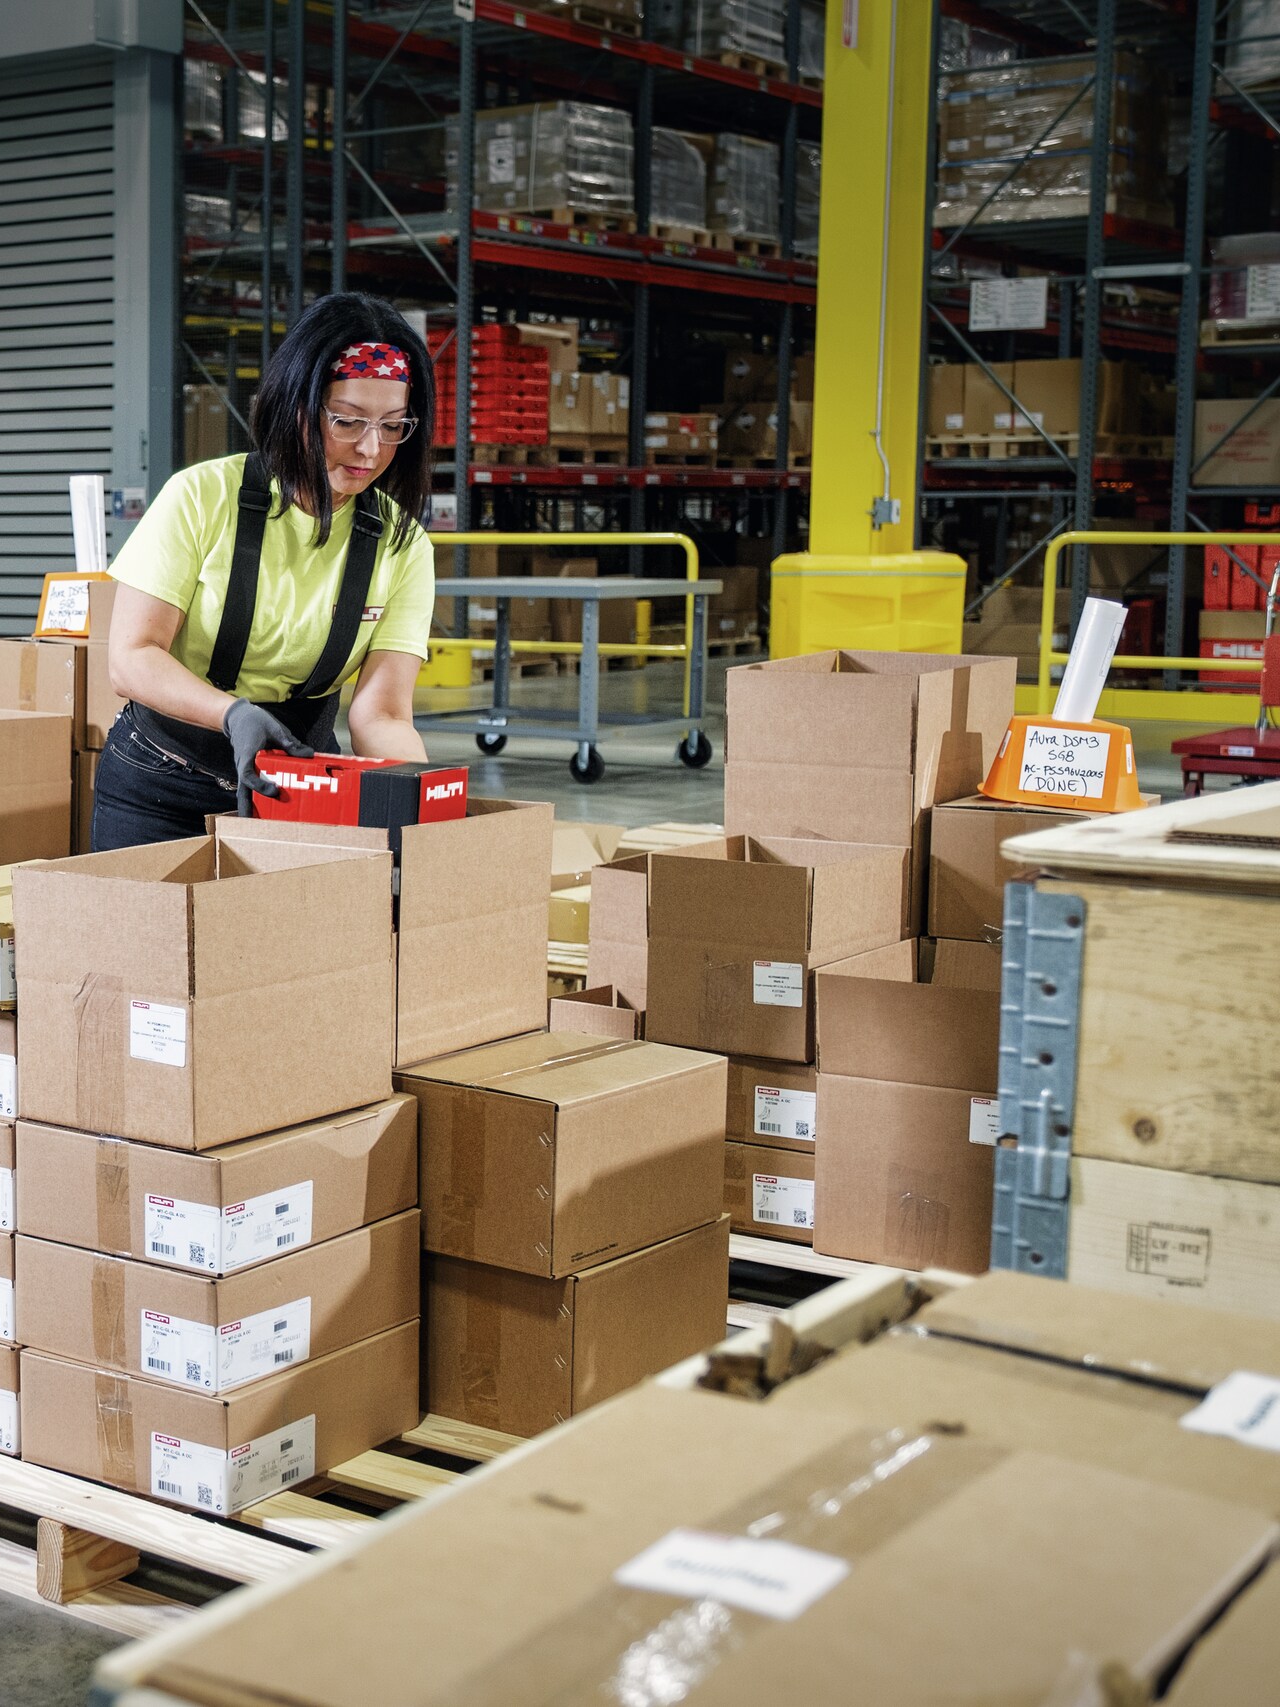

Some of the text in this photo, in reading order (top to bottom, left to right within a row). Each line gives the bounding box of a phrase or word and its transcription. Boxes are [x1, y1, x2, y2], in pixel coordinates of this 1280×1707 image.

[1213, 643, 1264, 658] HIL
[260, 770, 338, 793] HILTI
[426, 781, 464, 802] HILTI
[149, 1196, 174, 1207] HILTI
[225, 1203, 245, 1215] HILTI
[145, 1311, 170, 1324] HILTI
[221, 1321, 241, 1335] HILTI
[155, 1434, 180, 1447] HILTI
[231, 1444, 250, 1458] HILTI
